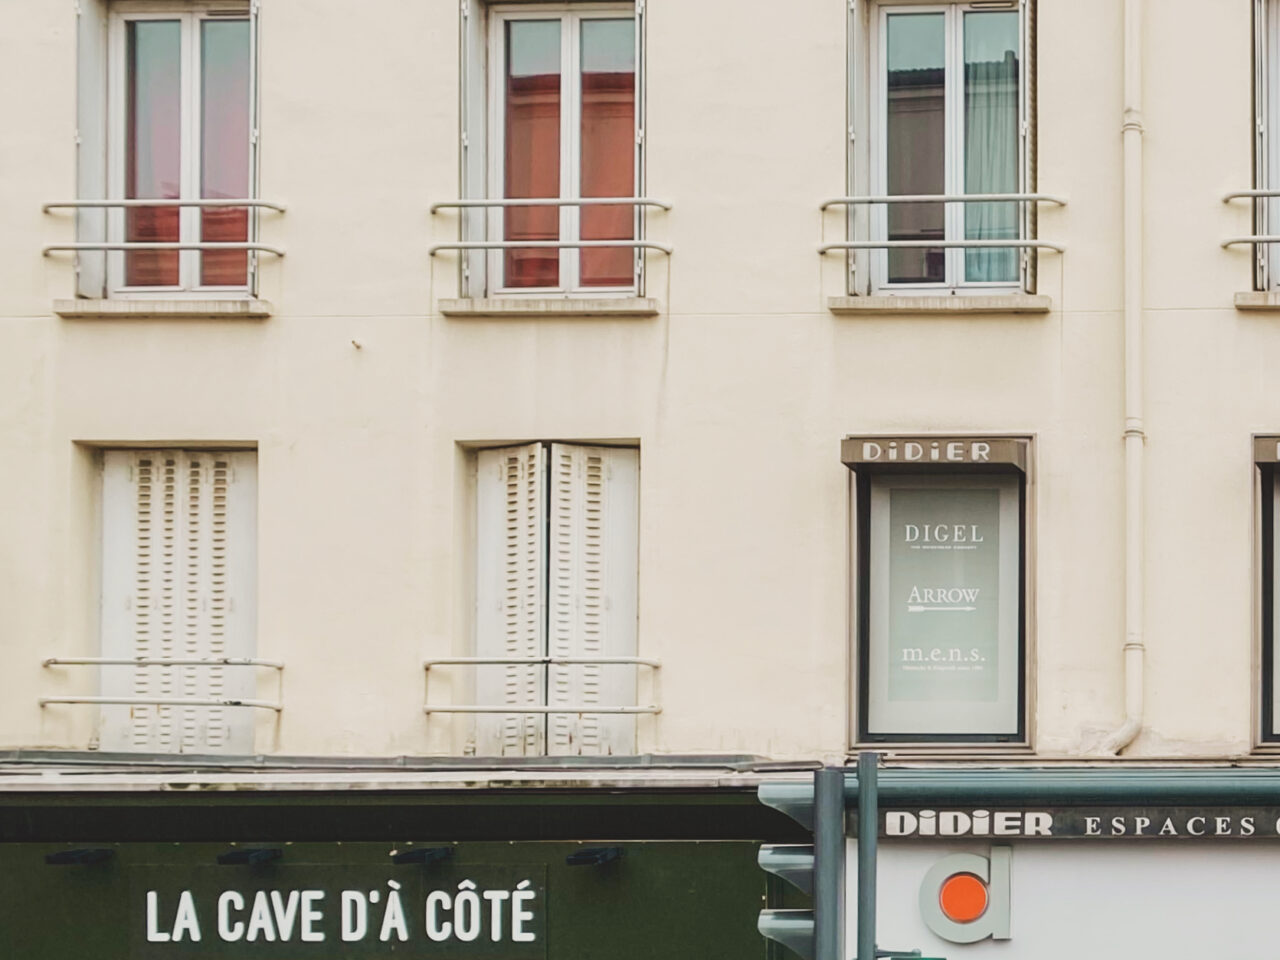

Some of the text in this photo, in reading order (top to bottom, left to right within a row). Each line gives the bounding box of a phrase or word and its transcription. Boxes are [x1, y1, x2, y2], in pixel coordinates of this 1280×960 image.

[862, 441, 991, 461] DiDiER
[905, 524, 984, 542] DIGEL
[902, 647, 986, 662] m.e.n.s.
[885, 809, 1054, 837] DiDiER
[1084, 816, 1257, 837] ESPACES
[146, 880, 536, 942] LA CAVE D'À CÔTÉ
